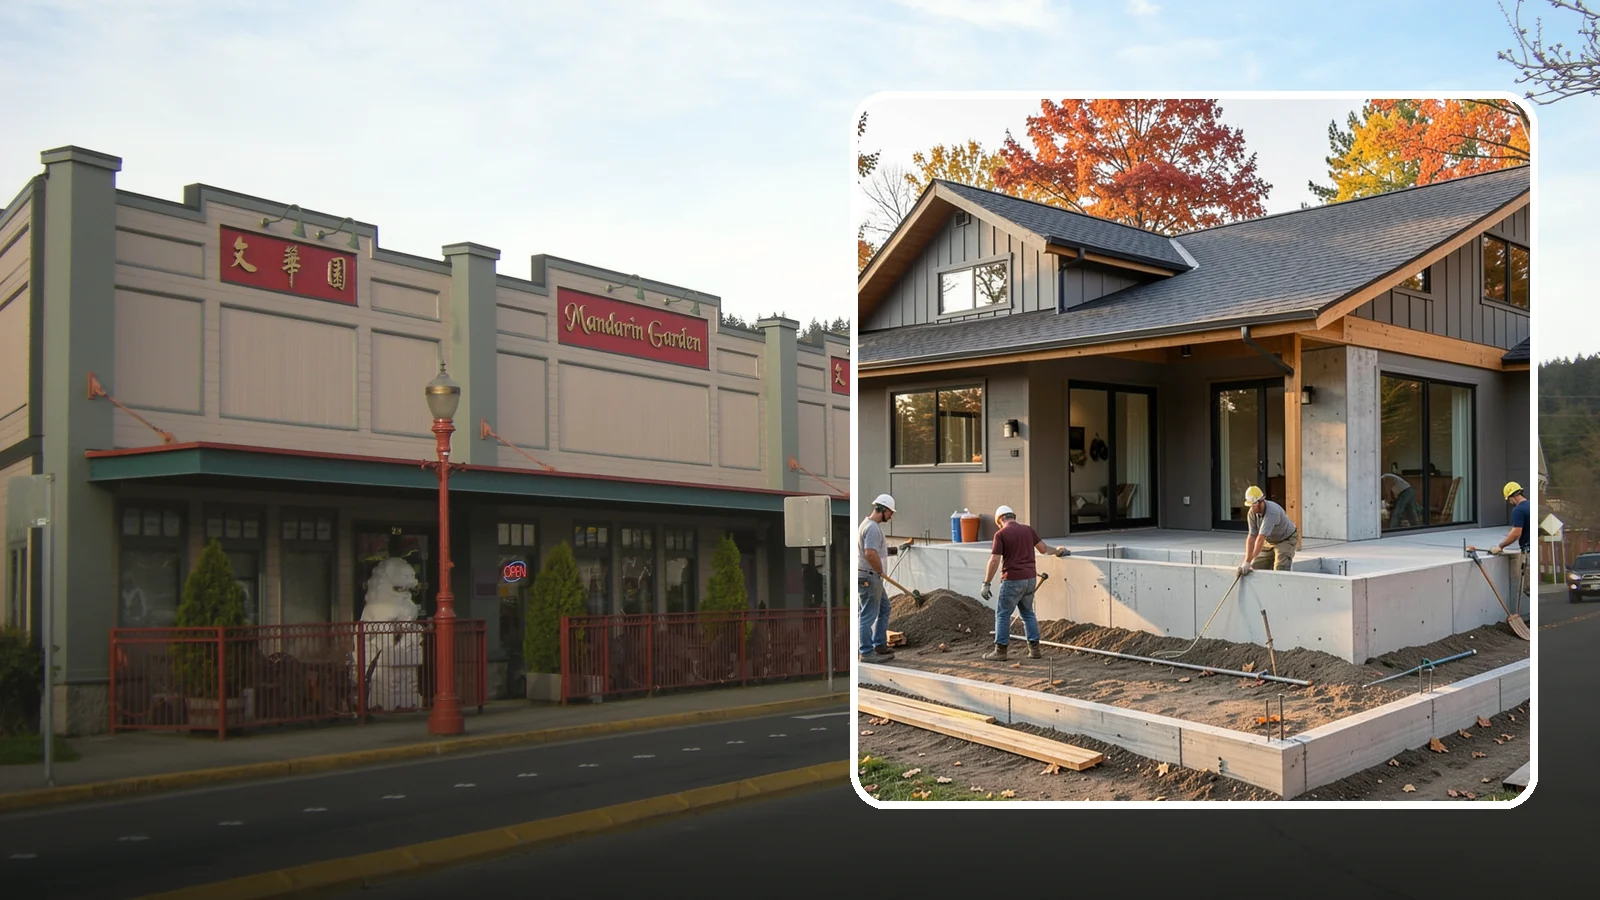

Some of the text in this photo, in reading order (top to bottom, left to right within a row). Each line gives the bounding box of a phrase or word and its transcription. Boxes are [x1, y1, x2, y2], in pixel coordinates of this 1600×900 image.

[230, 235, 346, 291] 文華園
[564, 302, 702, 352] Mandarin Garden
[503, 565, 527, 578] OPEN
